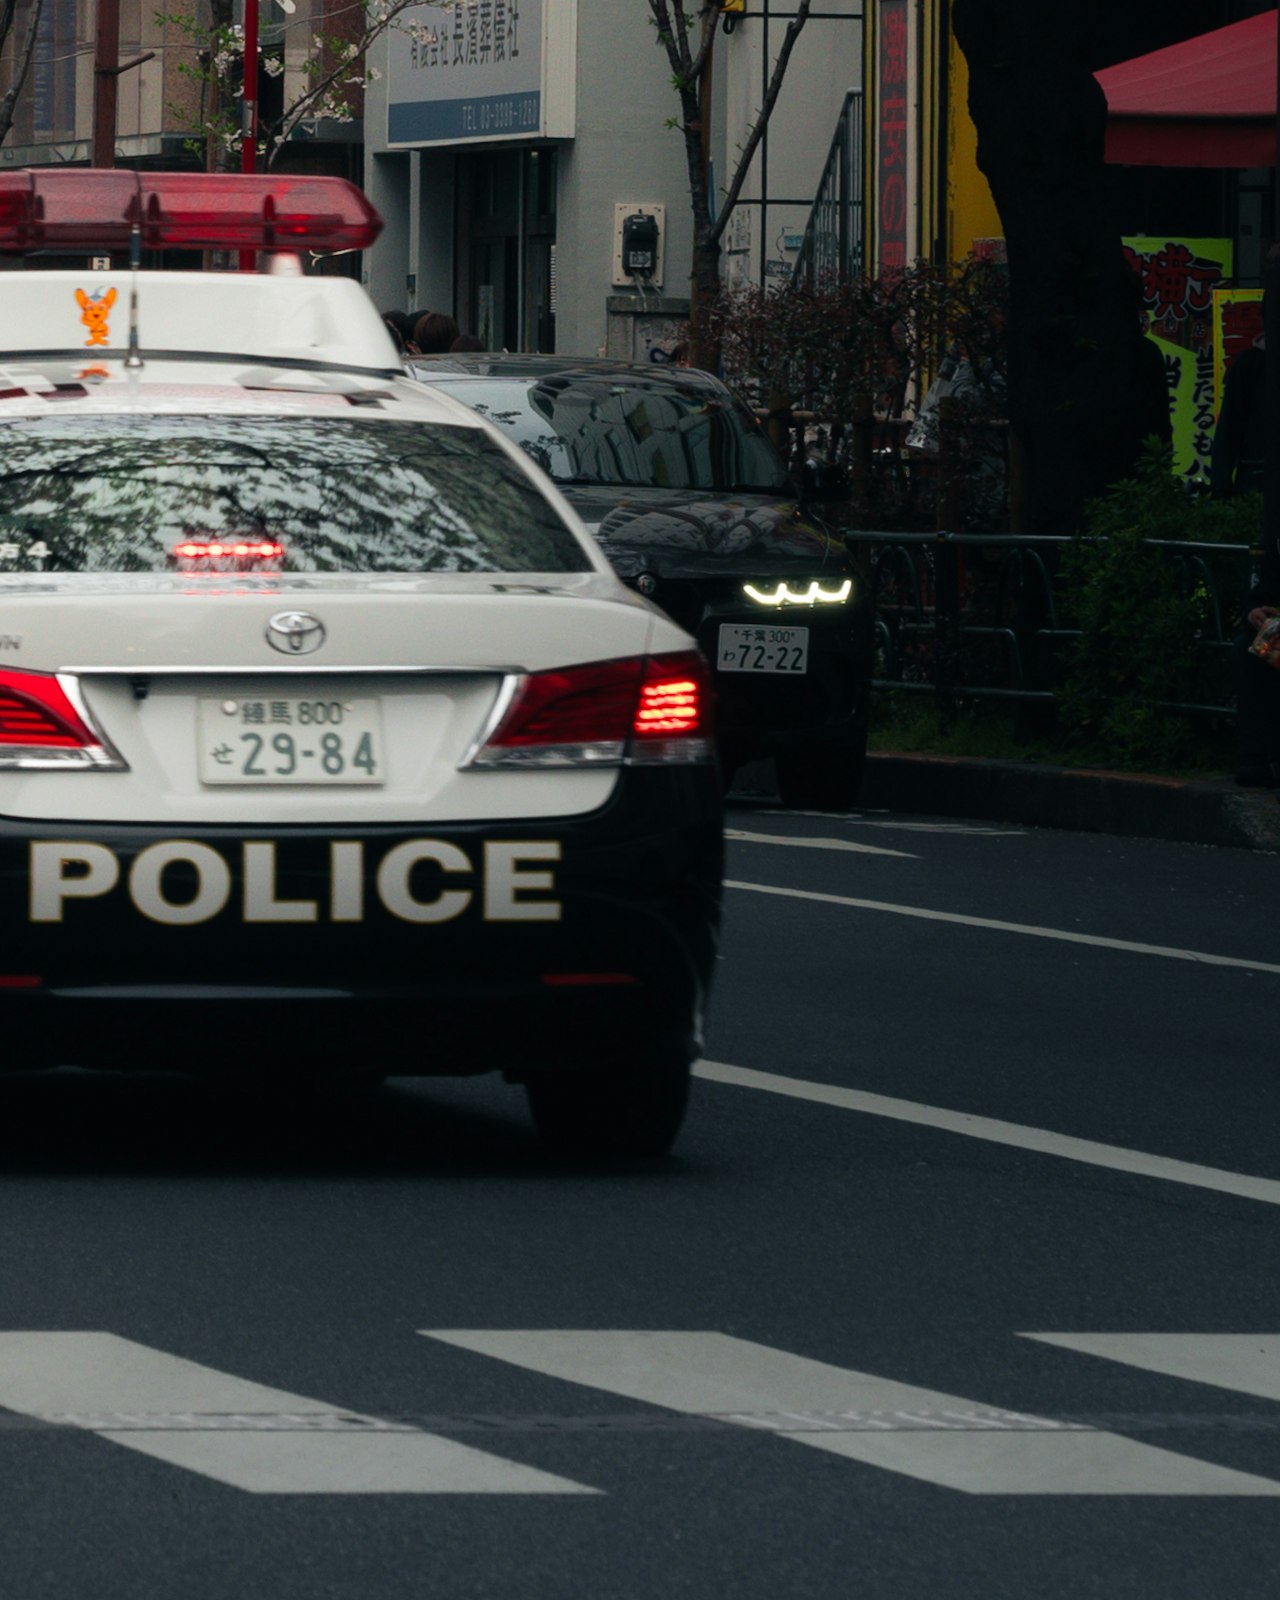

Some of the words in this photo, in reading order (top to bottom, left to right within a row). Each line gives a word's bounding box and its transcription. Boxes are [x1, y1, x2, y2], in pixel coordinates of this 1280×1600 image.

[741, 630, 766, 642] 千葉
[768, 630, 791, 643] 300
[723, 650, 736, 662] わ
[739, 644, 804, 671] 72-22
[241, 701, 292, 725] 練馬
[298, 701, 343, 725] 800
[210, 742, 236, 764] せ
[240, 731, 376, 775] 29-84
[27, 837, 564, 926] POLICE
